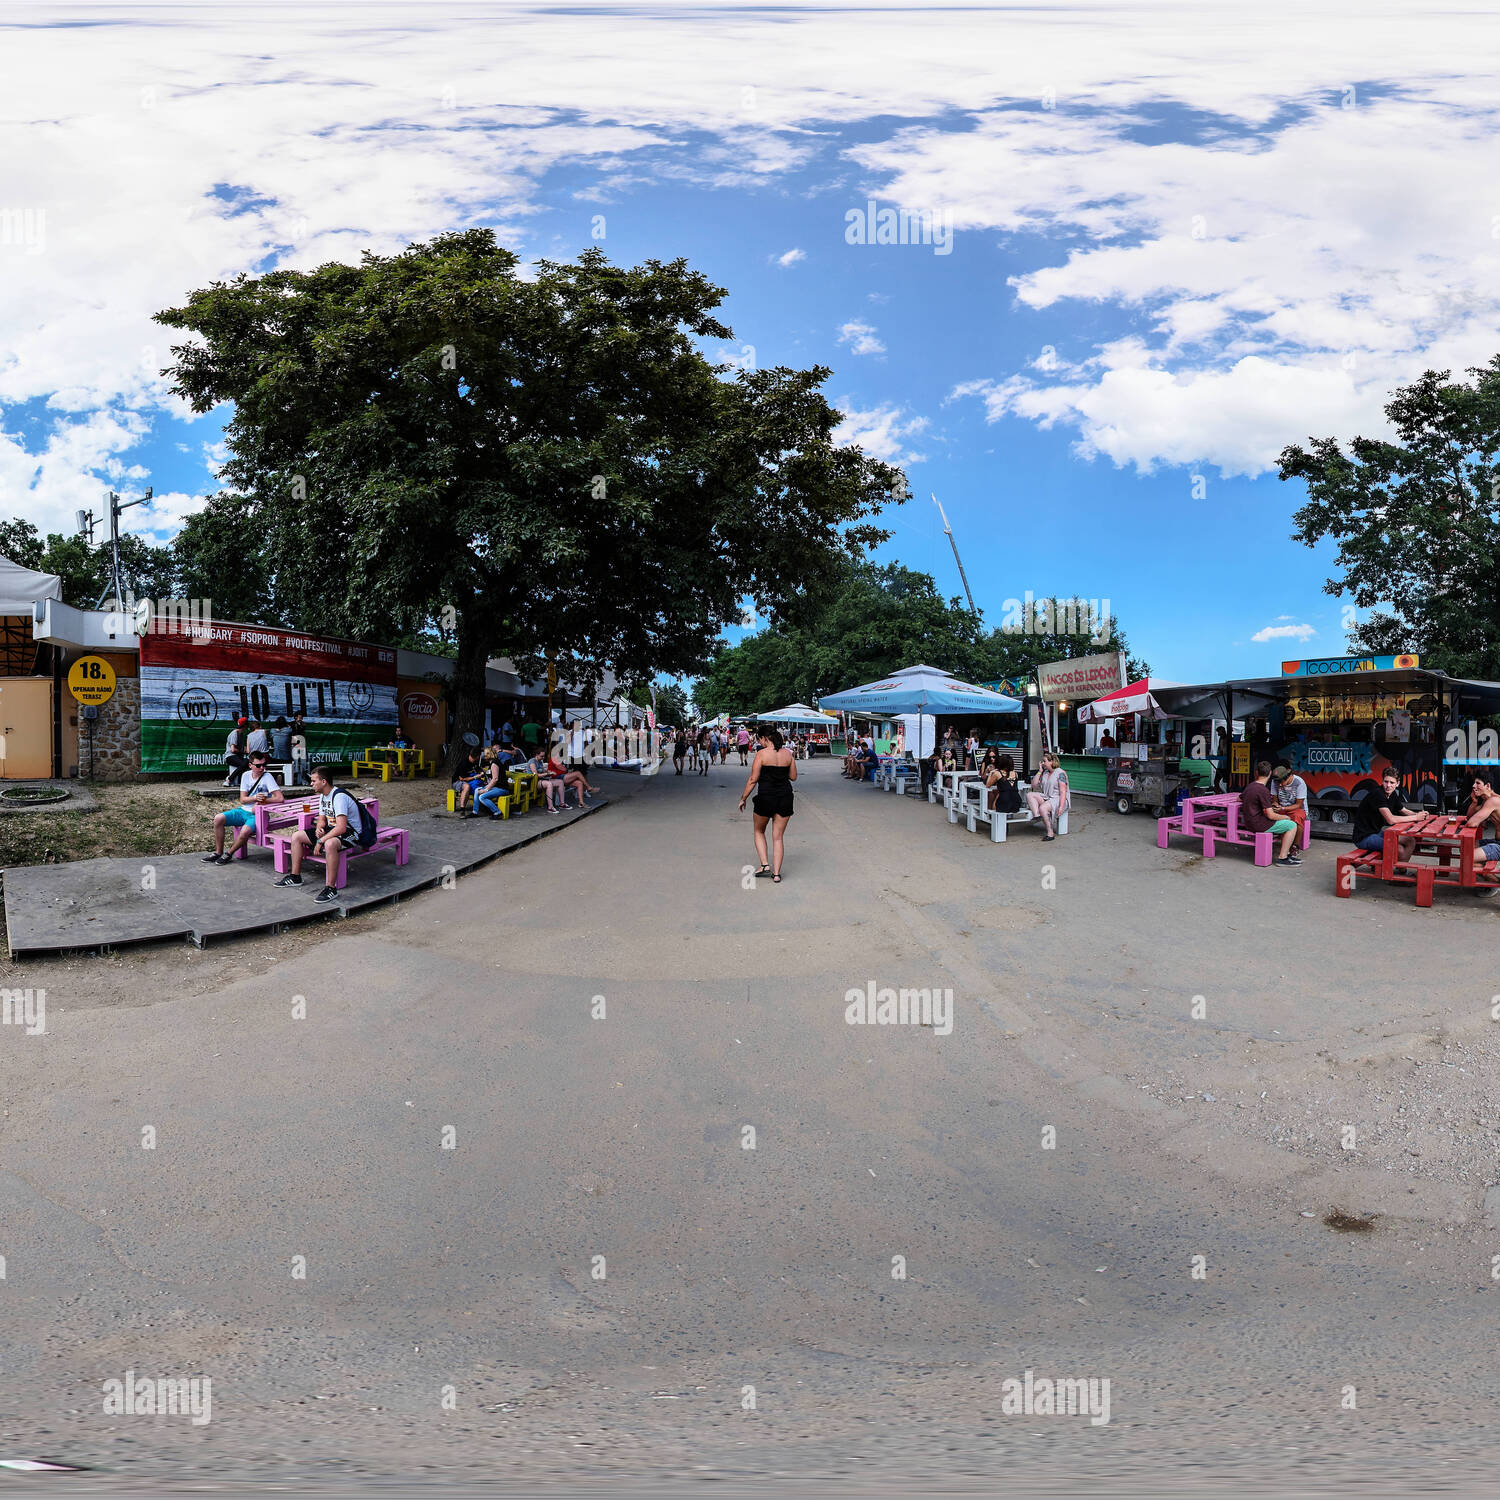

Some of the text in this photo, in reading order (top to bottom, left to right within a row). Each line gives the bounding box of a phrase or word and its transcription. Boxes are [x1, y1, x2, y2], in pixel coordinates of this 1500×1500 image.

[185, 626, 233, 641] #HUNGARY
[240, 631, 279, 646] #SOPRON
[285, 637, 342, 655] #VOLTFESZTIVAL
[80, 662, 106, 680] 18.
[1308, 660, 1372, 675] COCKTAIL
[1074, 669, 1085, 682] ÉS
[96, 685, 112, 693] RÁDIÓ
[183, 702, 211, 718] VOLT
[403, 697, 434, 714] Tercia
[1310, 751, 1351, 764] COCKTAIL
